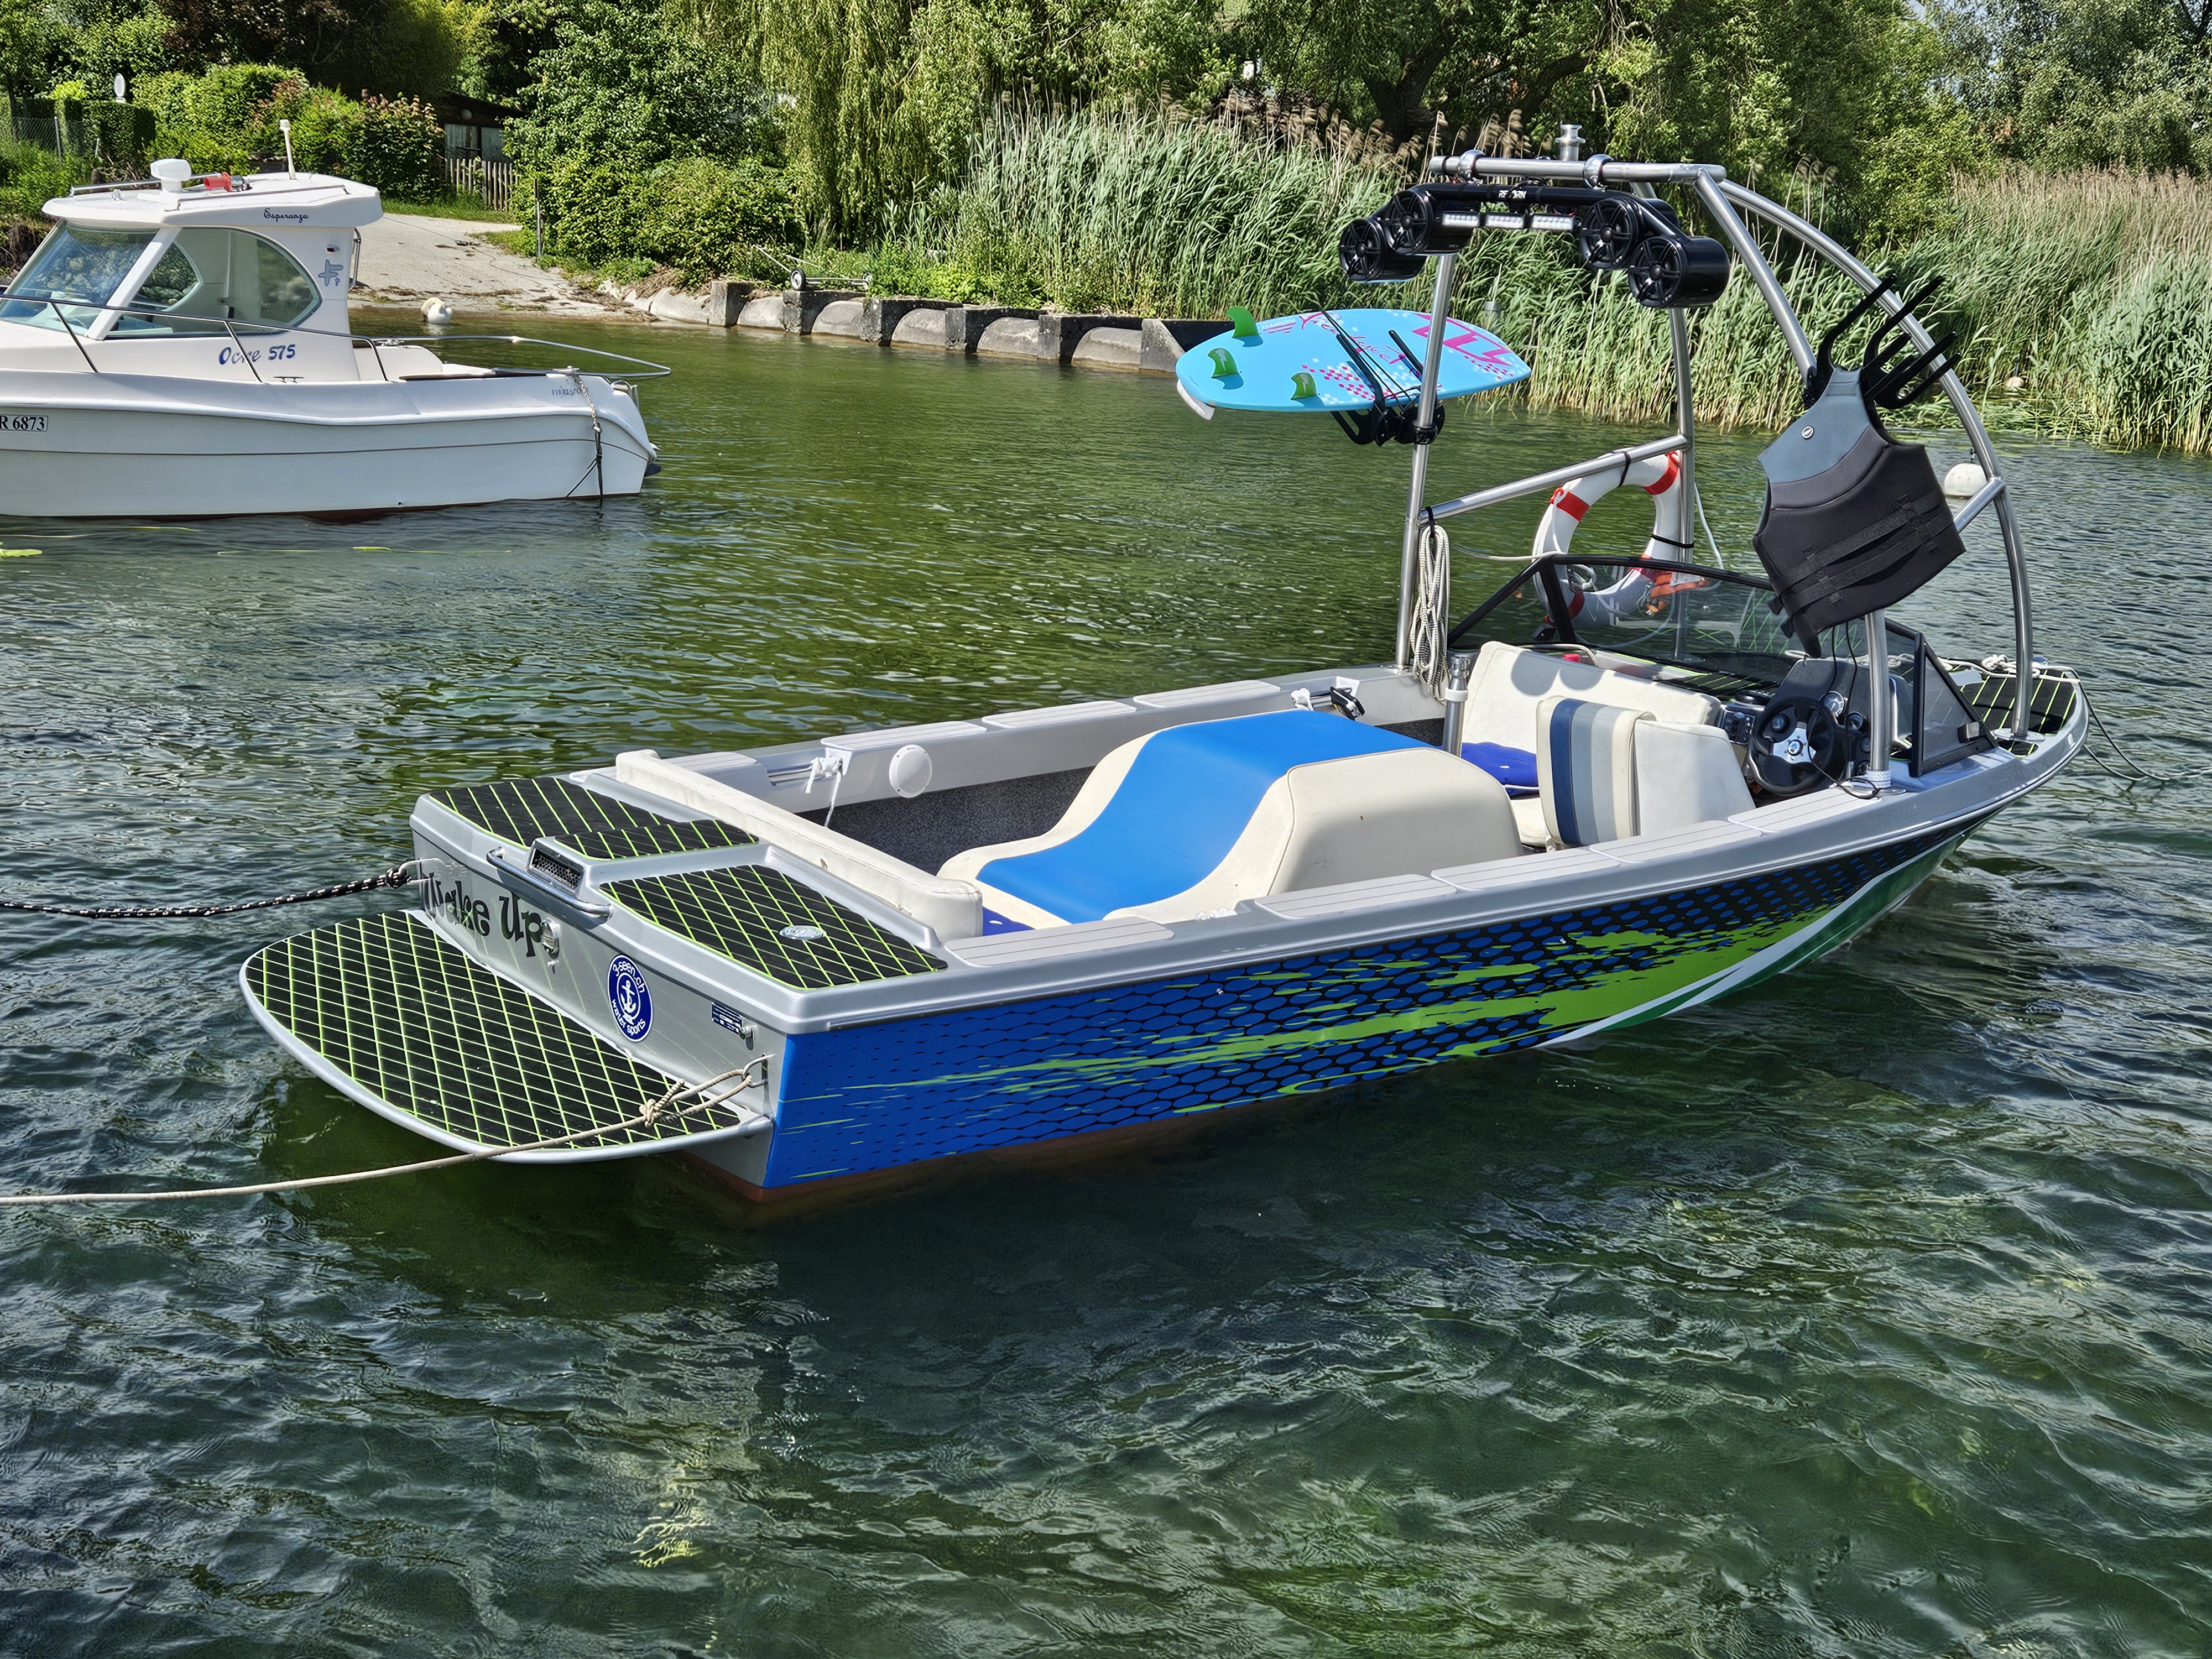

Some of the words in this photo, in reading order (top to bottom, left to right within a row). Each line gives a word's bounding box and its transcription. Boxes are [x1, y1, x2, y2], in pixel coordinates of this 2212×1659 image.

[1499, 190, 1527, 199] REORN
[263, 207, 309, 223] Esperanza
[268, 343, 296, 361] 575
[12, 415, 45, 431] 6873
[498, 892, 542, 957] Up
[612, 961, 645, 993] 3-seen.ch
[612, 999, 627, 1029] water
[626, 1018, 646, 1036] sports
